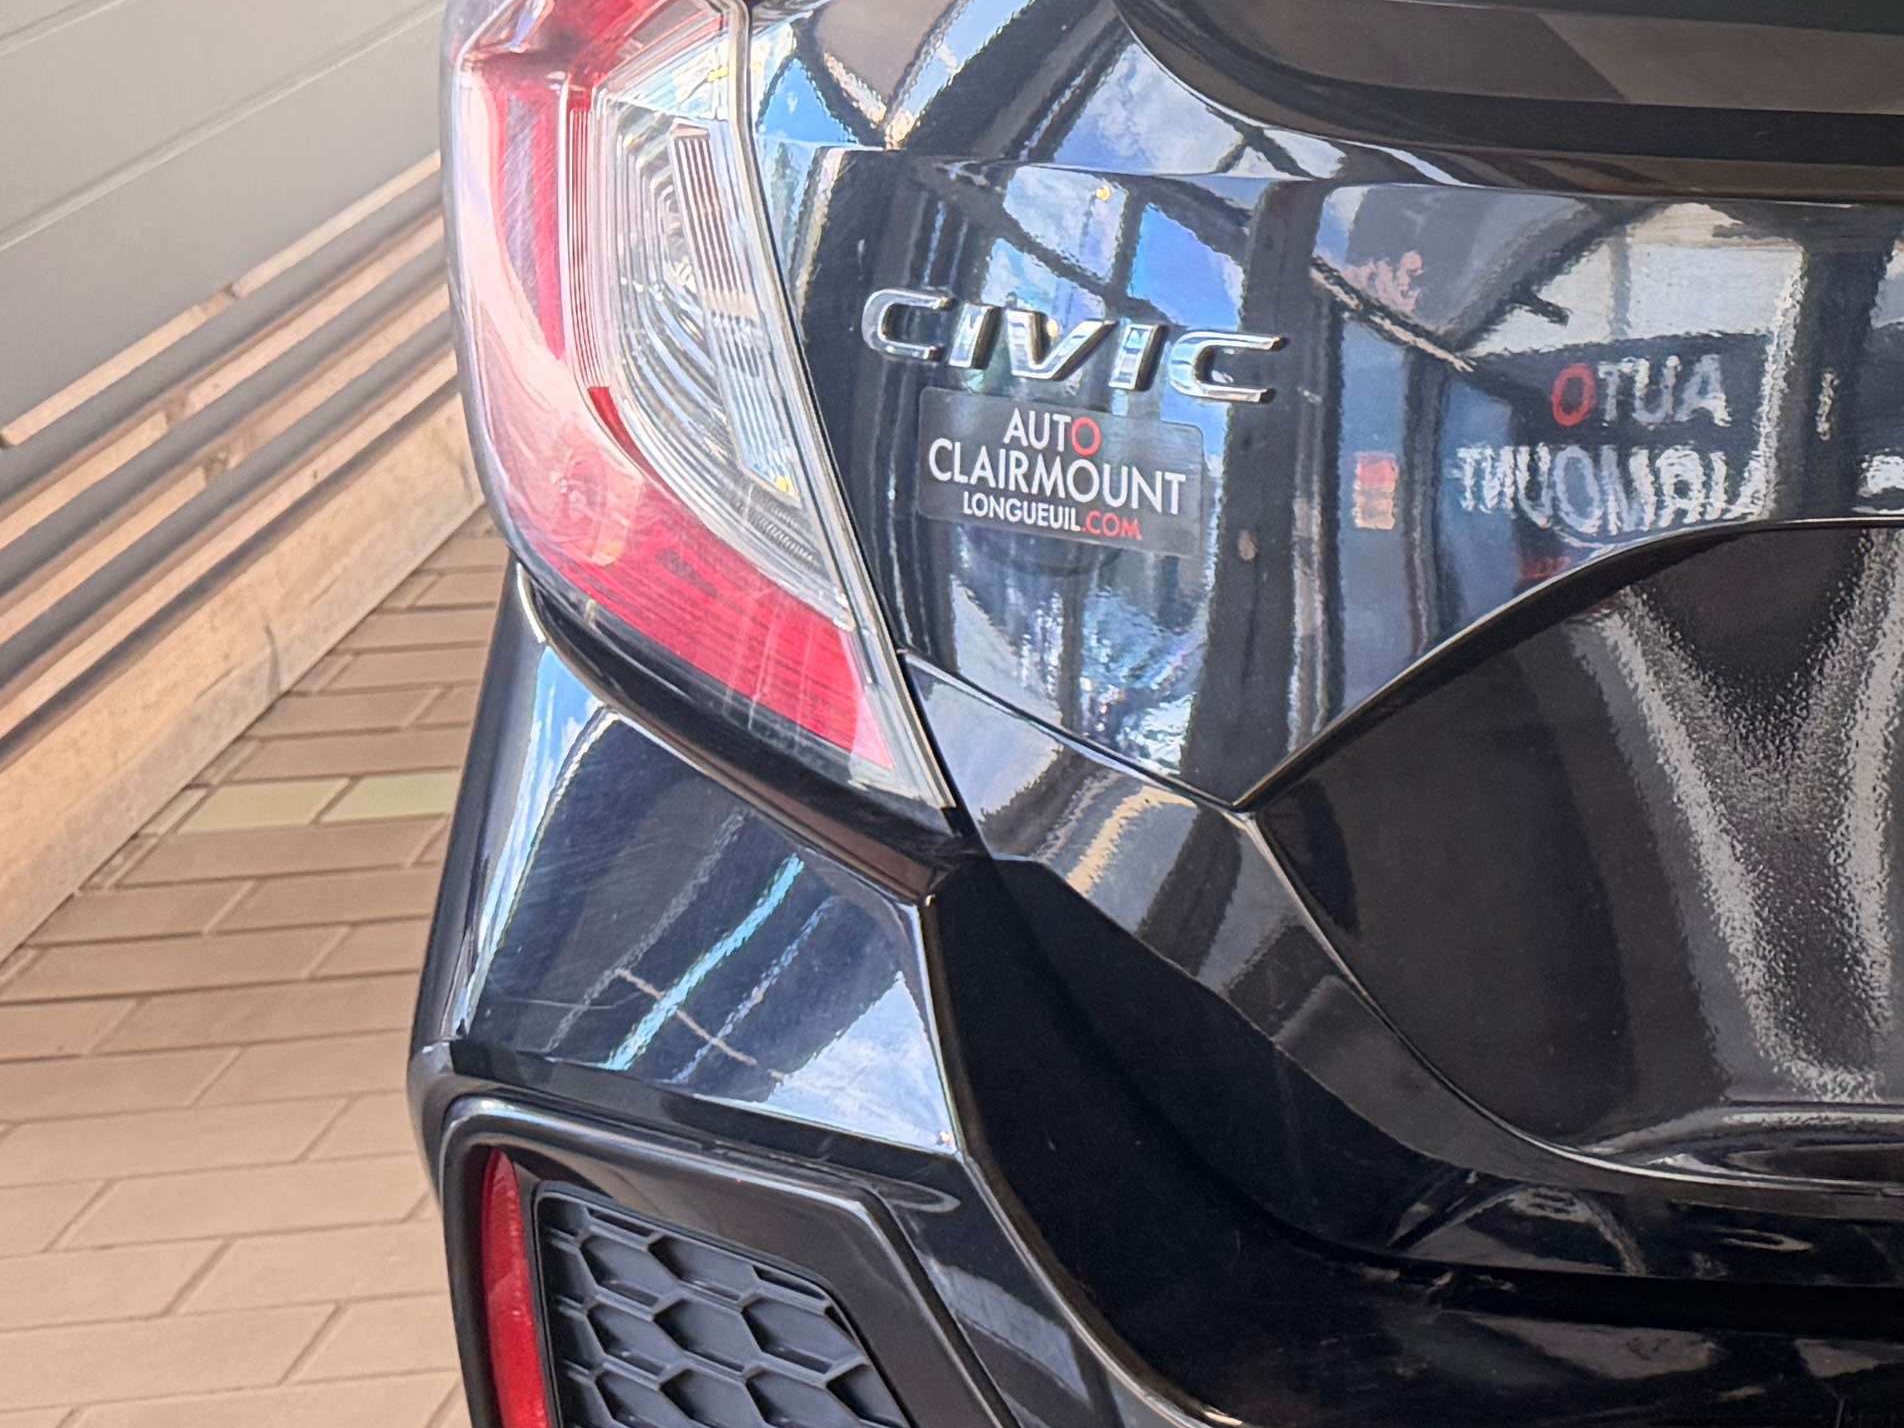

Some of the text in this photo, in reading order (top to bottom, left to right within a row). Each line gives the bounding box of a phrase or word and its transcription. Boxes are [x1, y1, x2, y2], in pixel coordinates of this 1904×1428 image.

[861, 288, 1288, 404] CIVIC
[1003, 408, 1100, 456] AUTO
[928, 438, 1186, 515] CLAIRMOUNT
[962, 490, 1143, 540] LONGUEUIL.COM
